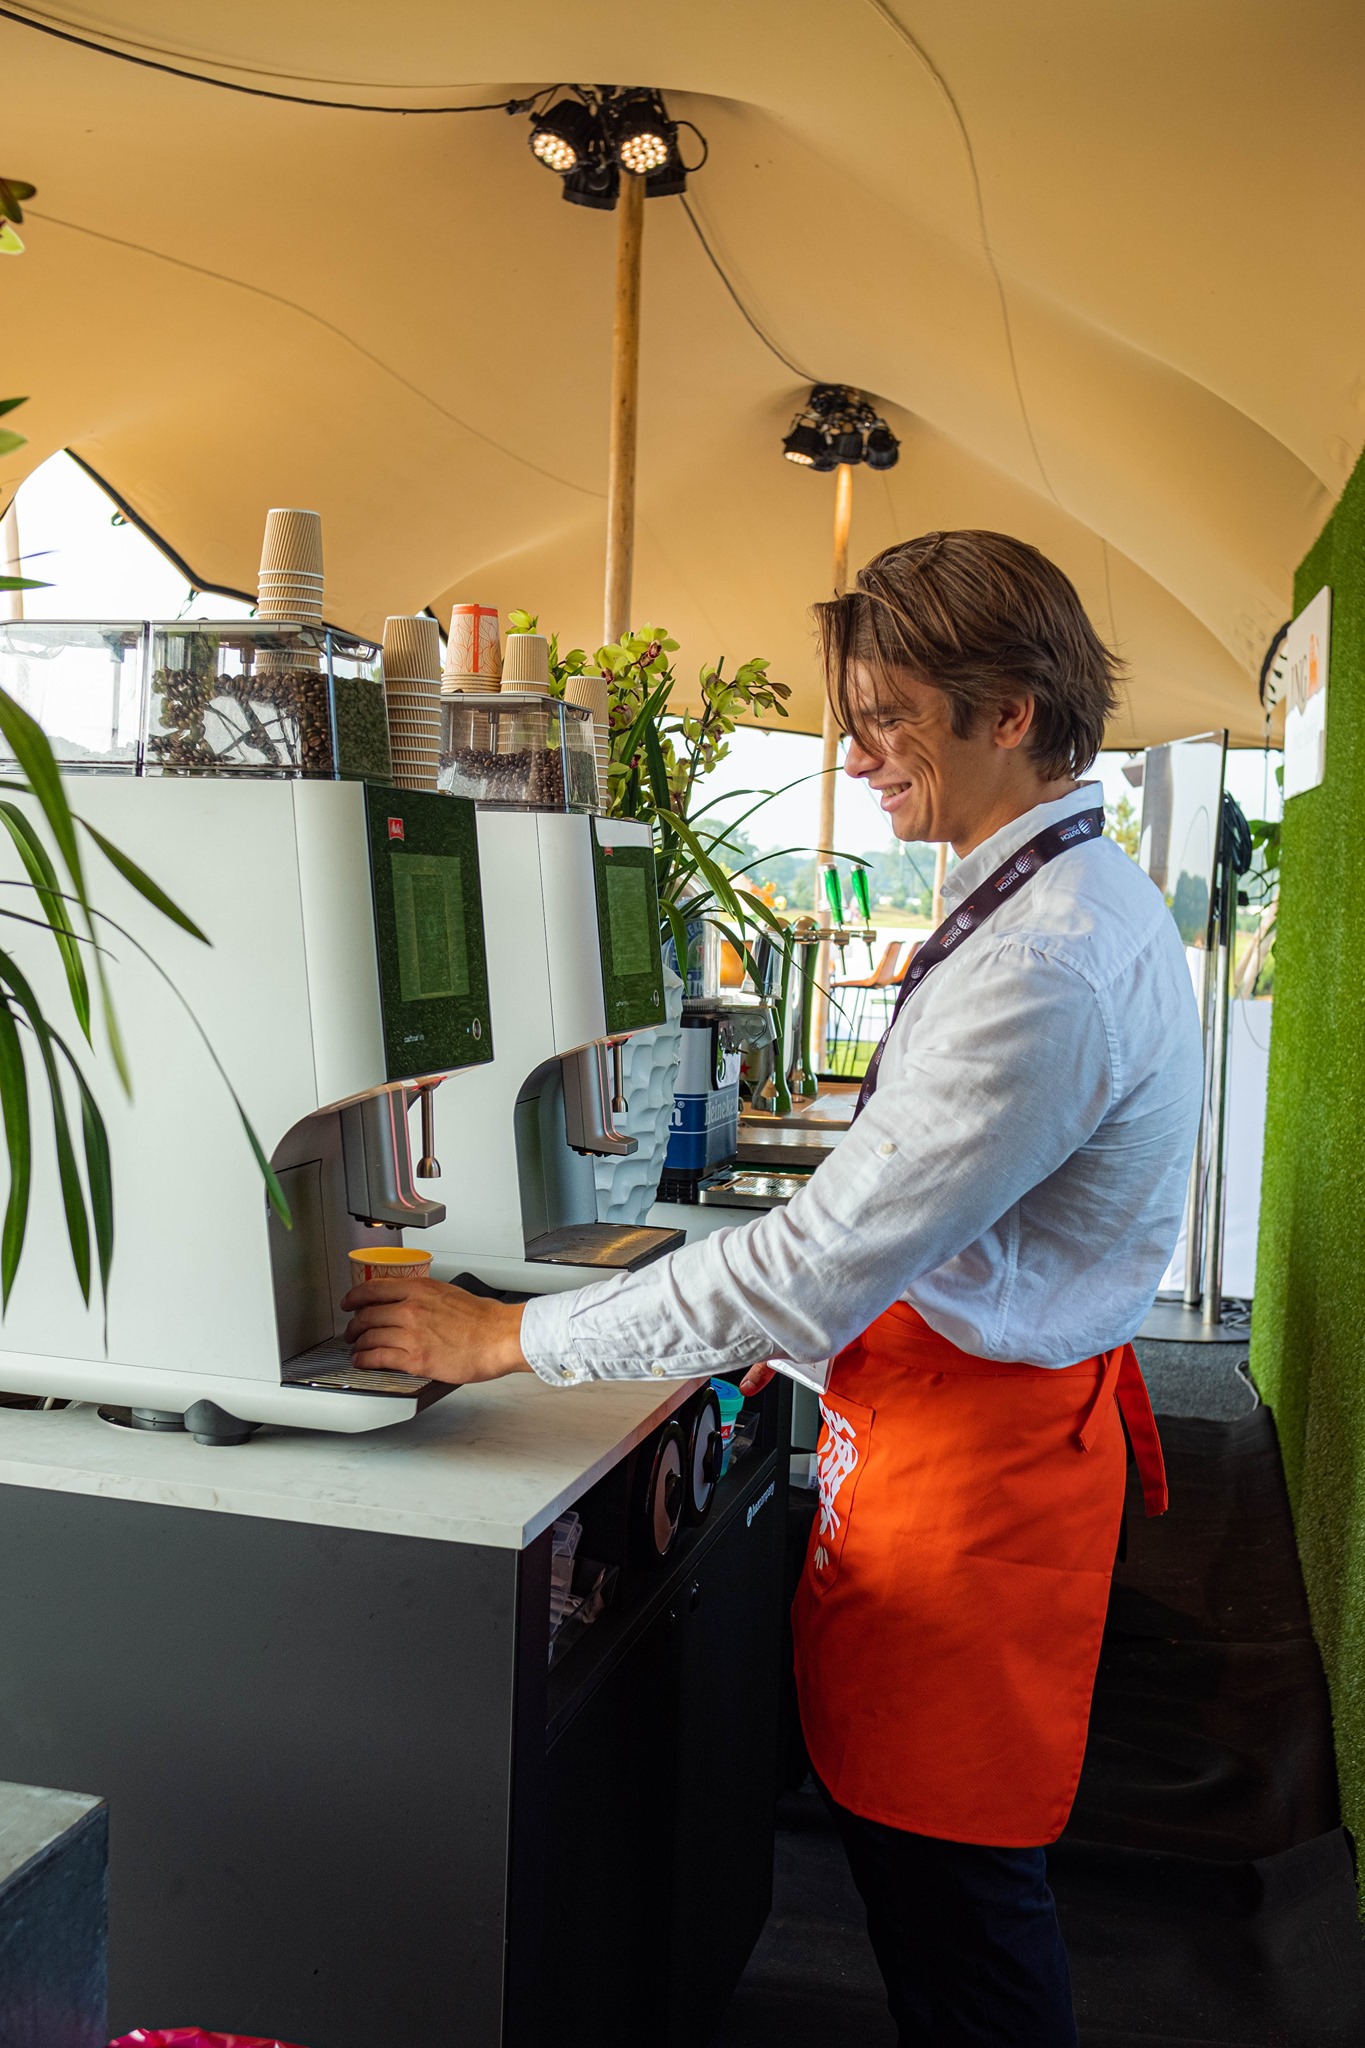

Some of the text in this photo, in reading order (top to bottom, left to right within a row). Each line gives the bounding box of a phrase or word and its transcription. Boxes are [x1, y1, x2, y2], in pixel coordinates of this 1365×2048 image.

[1060, 829, 1081, 842] DUTCH
[997, 871, 1020, 893] DUTCH
[942, 928, 962, 949] DUTCH
